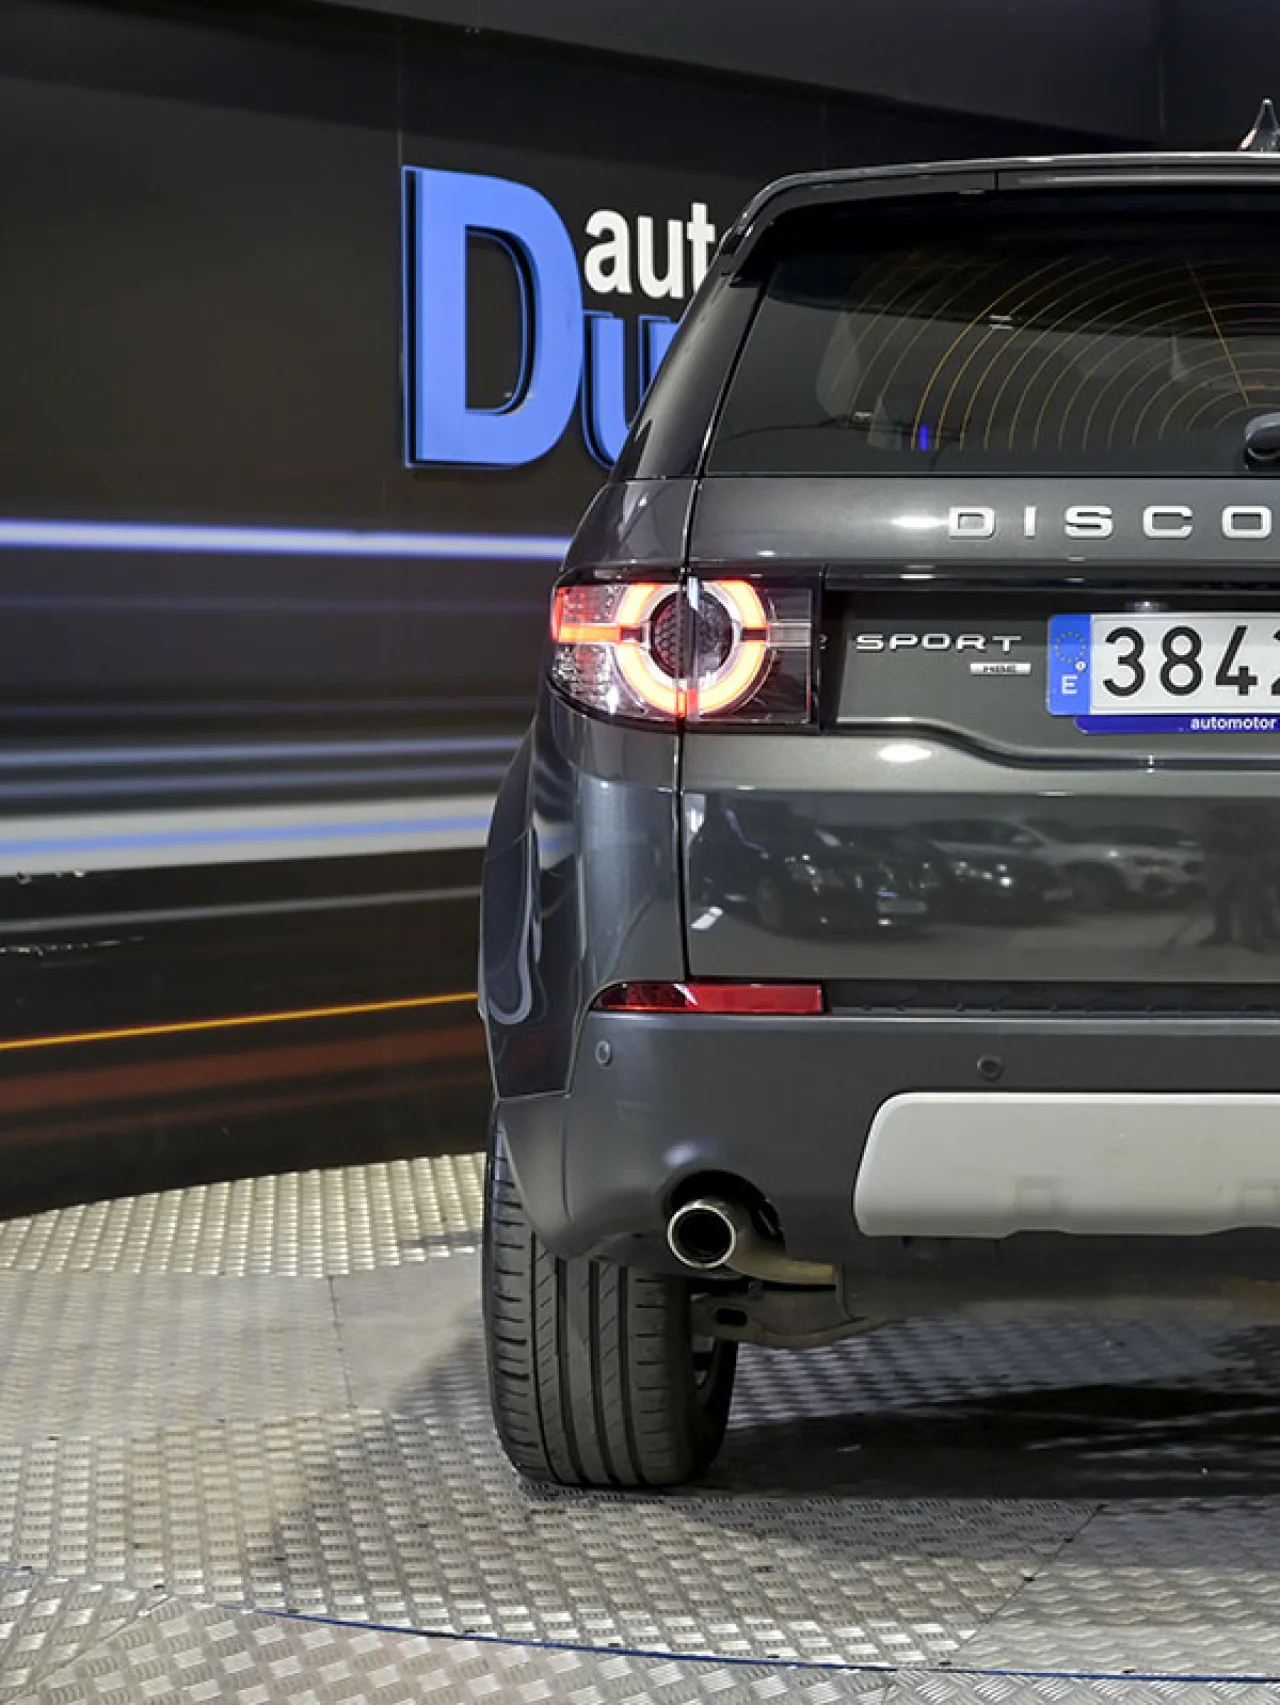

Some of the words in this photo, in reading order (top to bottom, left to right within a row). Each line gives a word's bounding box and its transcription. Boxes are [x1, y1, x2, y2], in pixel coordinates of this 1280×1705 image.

[855, 632, 1023, 652] SPORT
[1061, 674, 1078, 695] E
[1190, 716, 1278, 731] automotor
